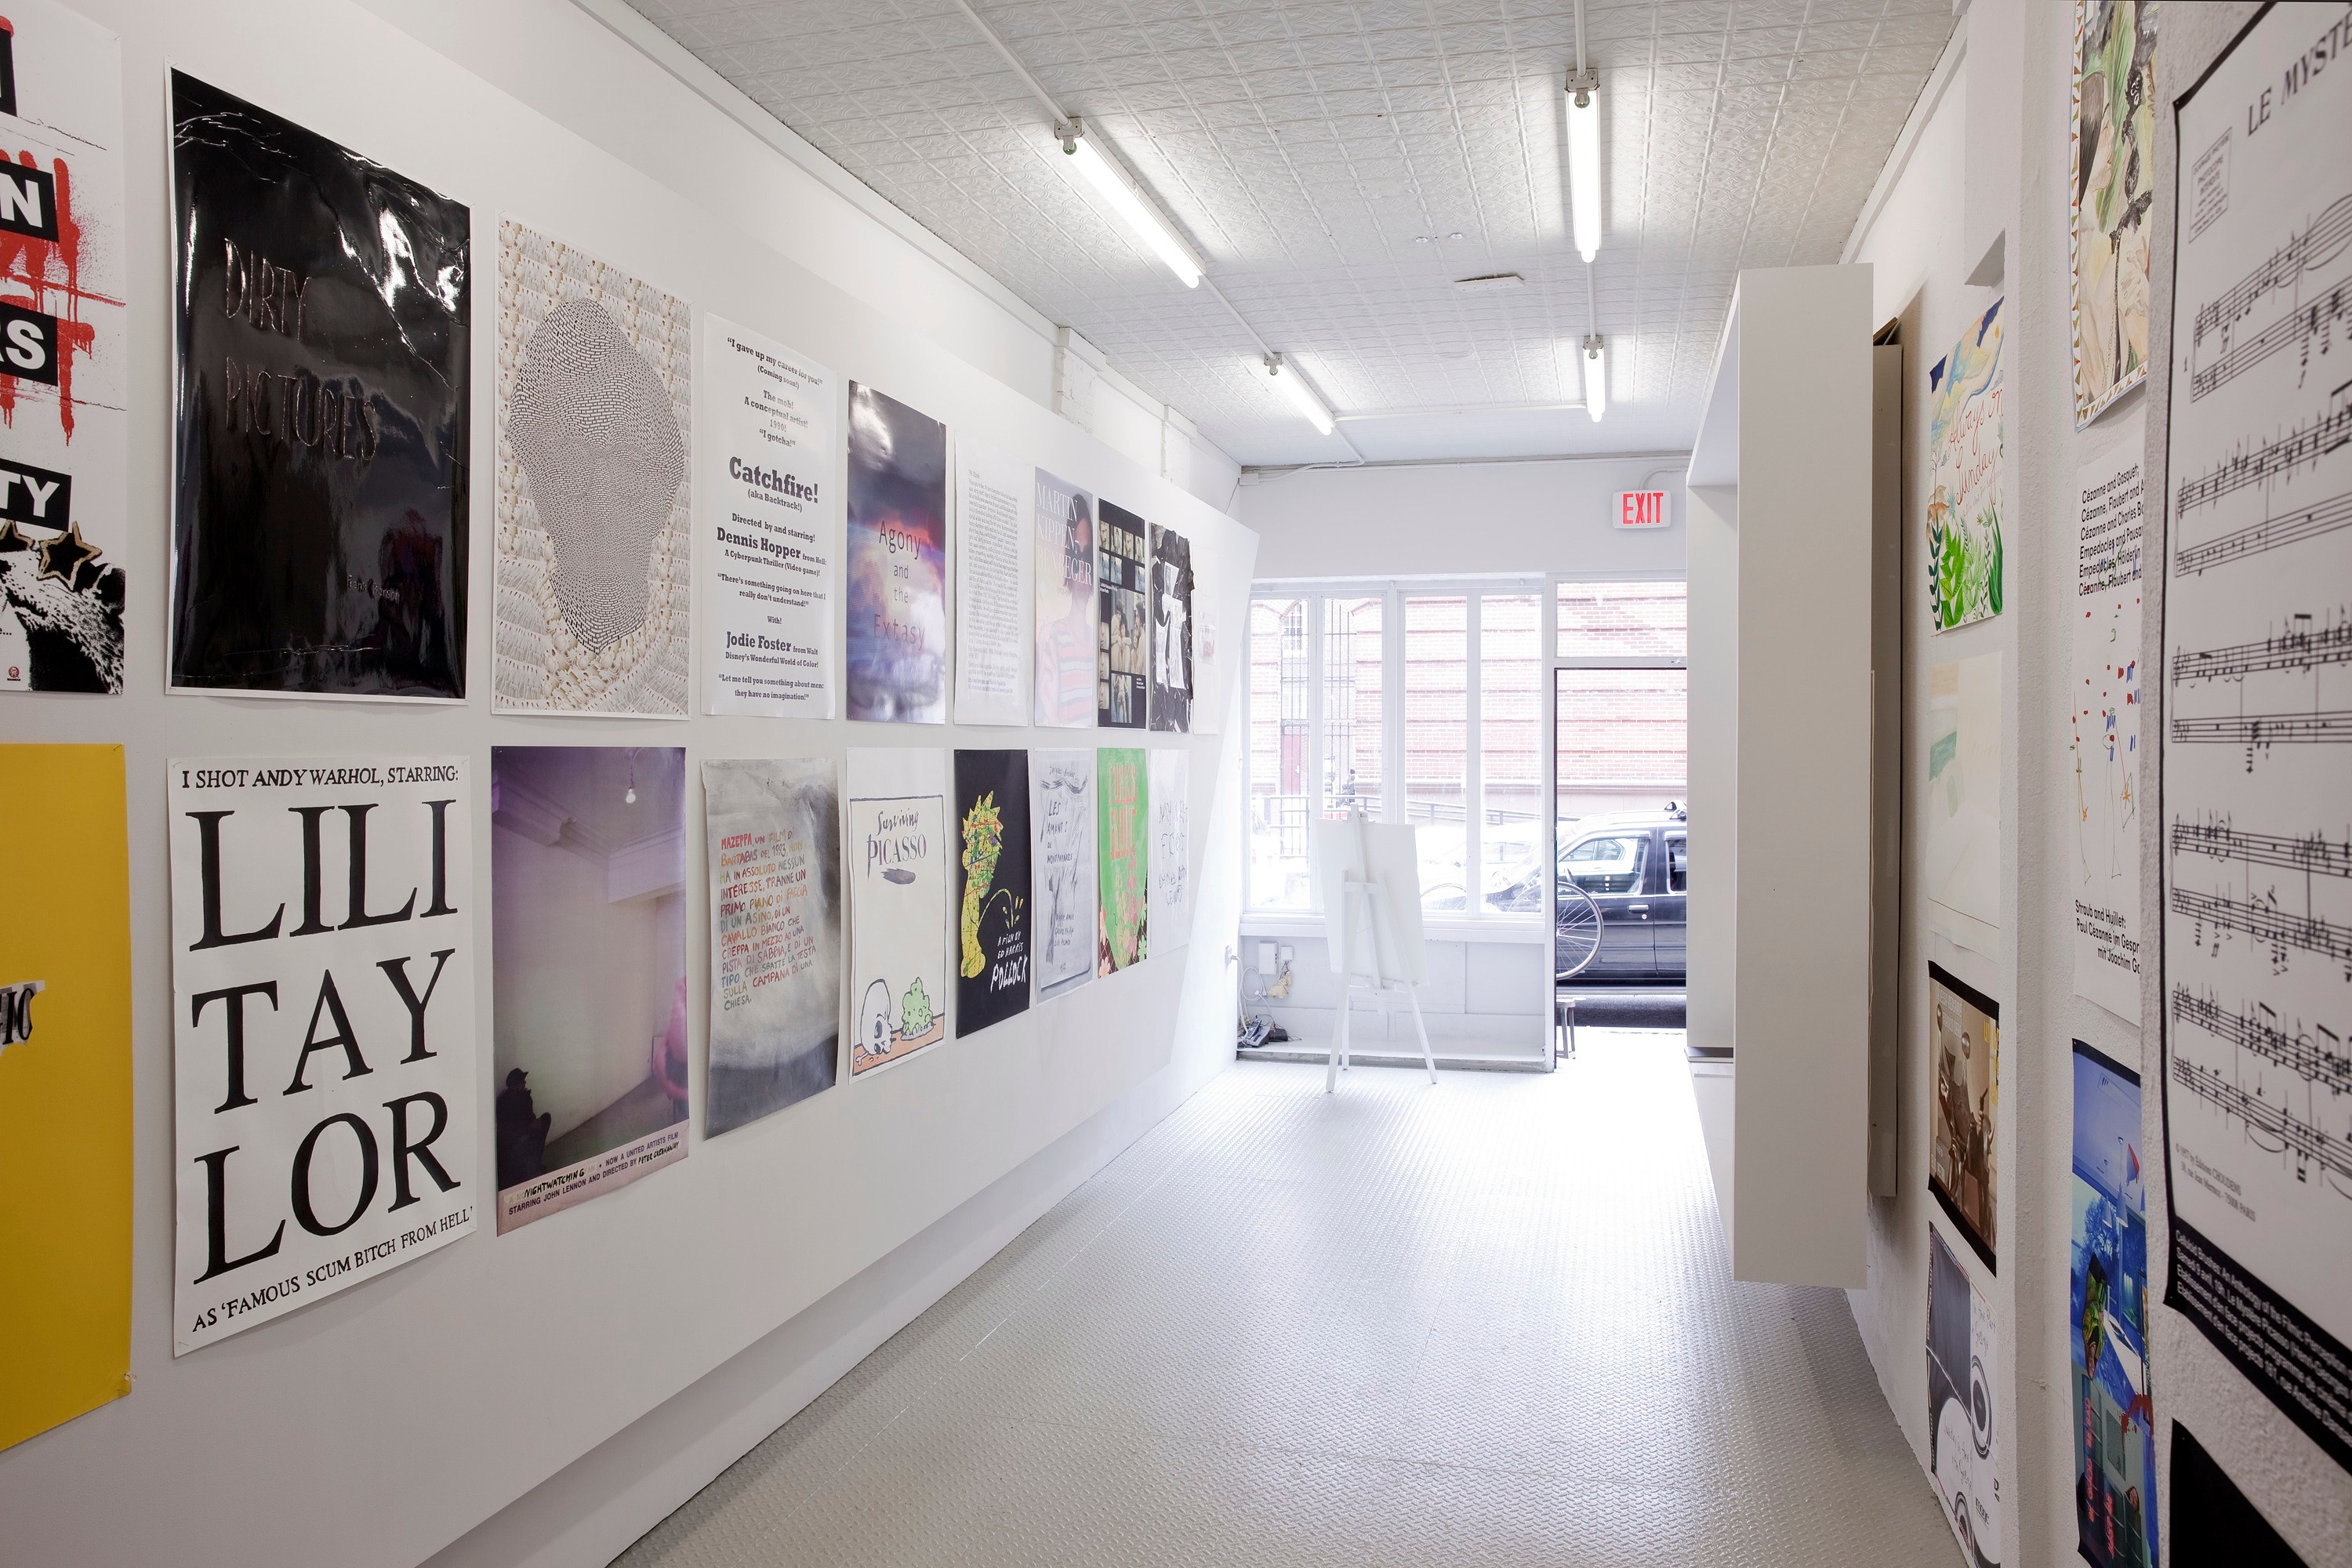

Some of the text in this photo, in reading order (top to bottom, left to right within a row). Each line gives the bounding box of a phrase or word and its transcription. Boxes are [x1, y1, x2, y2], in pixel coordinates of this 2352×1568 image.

[2248, 86, 2271, 137] LE
[224, 238, 312, 341] DIRTY
[0, 318, 45, 371] S
[737, 343, 753, 355] gave
[756, 350, 764, 361] up
[766, 356, 776, 367] my
[778, 361, 797, 375] career
[798, 369, 807, 379] for
[757, 365, 800, 389] (Coming soon!)
[226, 357, 377, 461] PICTURES
[729, 456, 818, 503] Catchfire!
[2082, 487, 2106, 503] Cézanne
[2107, 474, 2116, 491] and
[748, 488, 802, 513] (aka Backtrack!)
[1036, 483, 1077, 522] MARTIN
[1623, 492, 1663, 524] EXIT
[2082, 482, 2139, 522] Cézanne, Flaubert and
[732, 513, 815, 543] Directed by and starring!
[2081, 508, 2136, 541] Cézanne and Charles
[717, 527, 758, 549] Dennis
[760, 537, 800, 559] Hopper
[802, 553, 815, 562] from
[879, 519, 921, 561] Agony
[2080, 539, 2114, 560] Empedocles
[2117, 530, 2125, 546] and
[731, 550, 762, 564] Cyberpunk
[763, 557, 784, 568] Thriller
[785, 563, 801, 572] (Video
[803, 568, 820, 577] game)!
[893, 564, 909, 580] and
[2108, 572, 2131, 589] Flaubert
[2132, 567, 2141, 579] and
[739, 591, 756, 600] really
[745, 579, 775, 592] something
[775, 586, 792, 595] going
[800, 589, 812, 597] here
[893, 586, 909, 603] the
[768, 615, 782, 624] With!
[873, 613, 925, 649] Extasy
[727, 631, 755, 648] Jodie
[758, 635, 791, 652] Foster
[793, 645, 806, 654] from
[750, 655, 779, 664] Wonderful
[780, 657, 796, 666] World
[735, 689, 747, 699] they
[764, 679, 793, 688] something
[182, 765, 459, 789] I SHOT ANDY WARHOL, STARRING:
[877, 808, 919, 836] Surviving
[1049, 800, 1061, 816] LES
[768, 829, 786, 841] FILM
[720, 870, 731, 884] HA
[742, 862, 776, 878] ASSOLUTO
[779, 854, 804, 871] NESSUN
[761, 850, 770, 859] DEL
[867, 834, 926, 880] PICASSO
[185, 799, 457, 953] LILI
[2075, 899, 2125, 929] Straub and Huillet:
[998, 931, 1021, 946] A BY
[2077, 918, 2088, 934] Paul
[2089, 922, 2112, 943] Cézanne
[2113, 931, 2120, 946] im
[990, 954, 1028, 993] POLLOCK
[2107, 949, 2130, 971] Joachim
[192, 948, 456, 1115] TAY
[524, 1168, 585, 1198] NIGHTWATCHING
[605, 1155, 618, 1166] NOW
[626, 1145, 644, 1158] UNITED
[647, 1137, 666, 1149] ARTISTS
[668, 1132, 678, 1142] FILM
[194, 1091, 461, 1285] LOR
[509, 1196, 541, 1215] STARRING
[543, 1189, 560, 1202] JOHN
[562, 1179, 586, 1194] LENNON
[589, 1174, 600, 1184] AND
[603, 1163, 628, 1178] DIRECTED
[630, 1158, 637, 1167] BY
[638, 1153, 653, 1165] PETER
[192, 1308, 217, 1333] AS
[307, 1256, 352, 1285] SCUM
[354, 1237, 396, 1272] BITCH
[400, 1221, 437, 1248] FROM
